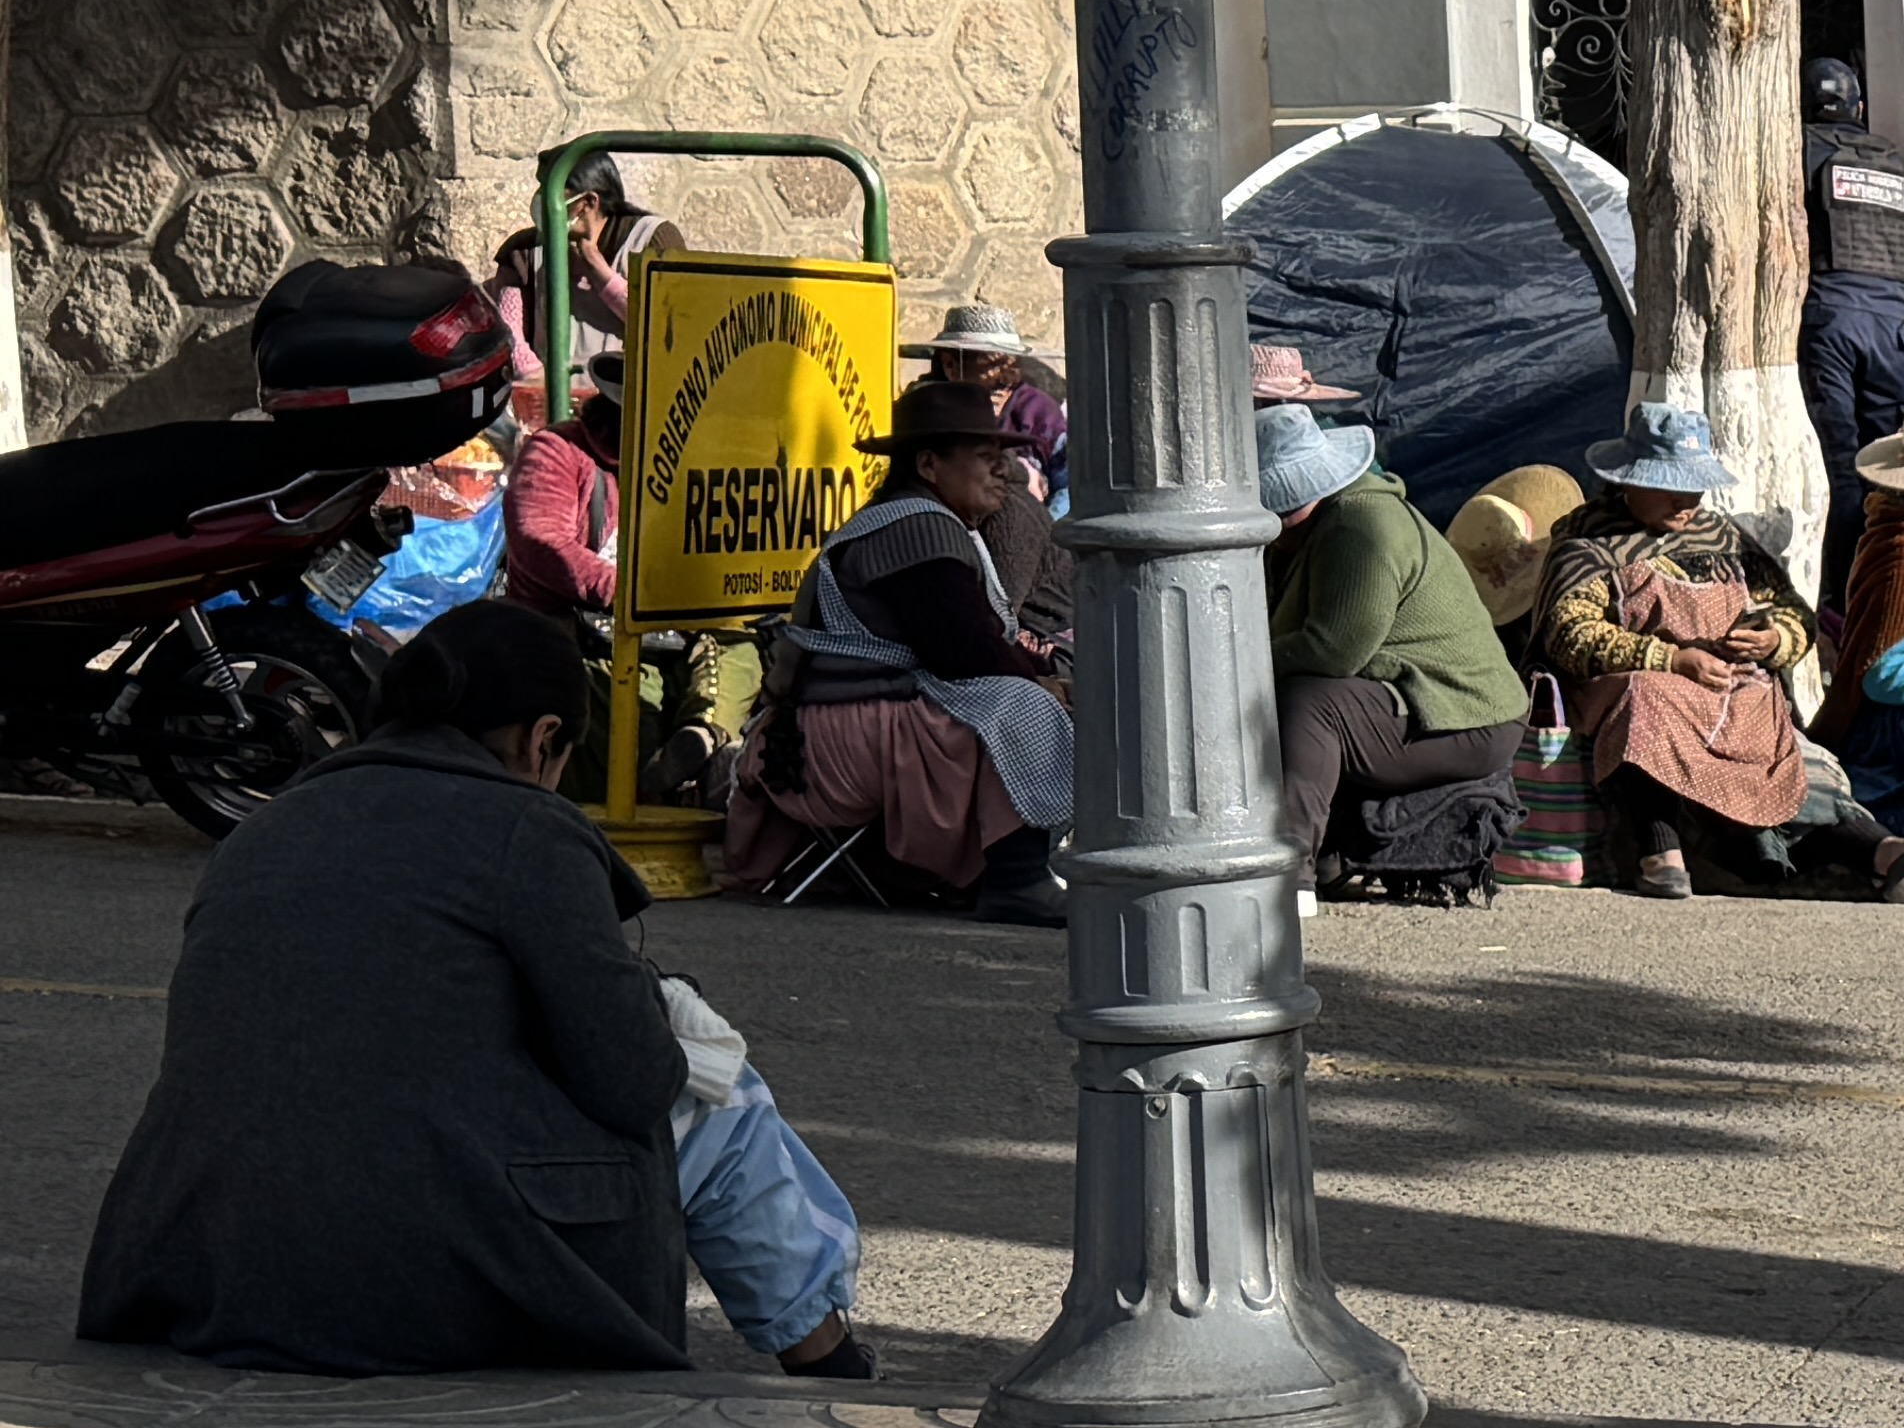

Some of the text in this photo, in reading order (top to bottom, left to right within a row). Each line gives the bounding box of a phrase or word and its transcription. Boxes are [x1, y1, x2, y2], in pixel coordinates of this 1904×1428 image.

[646, 356, 708, 506] GOBIERNO
[779, 291, 844, 387] MUNICIPAL
[838, 356, 860, 413] DE
[683, 466, 857, 555] RESERVADO
[772, 570, 806, 592] BOLI
